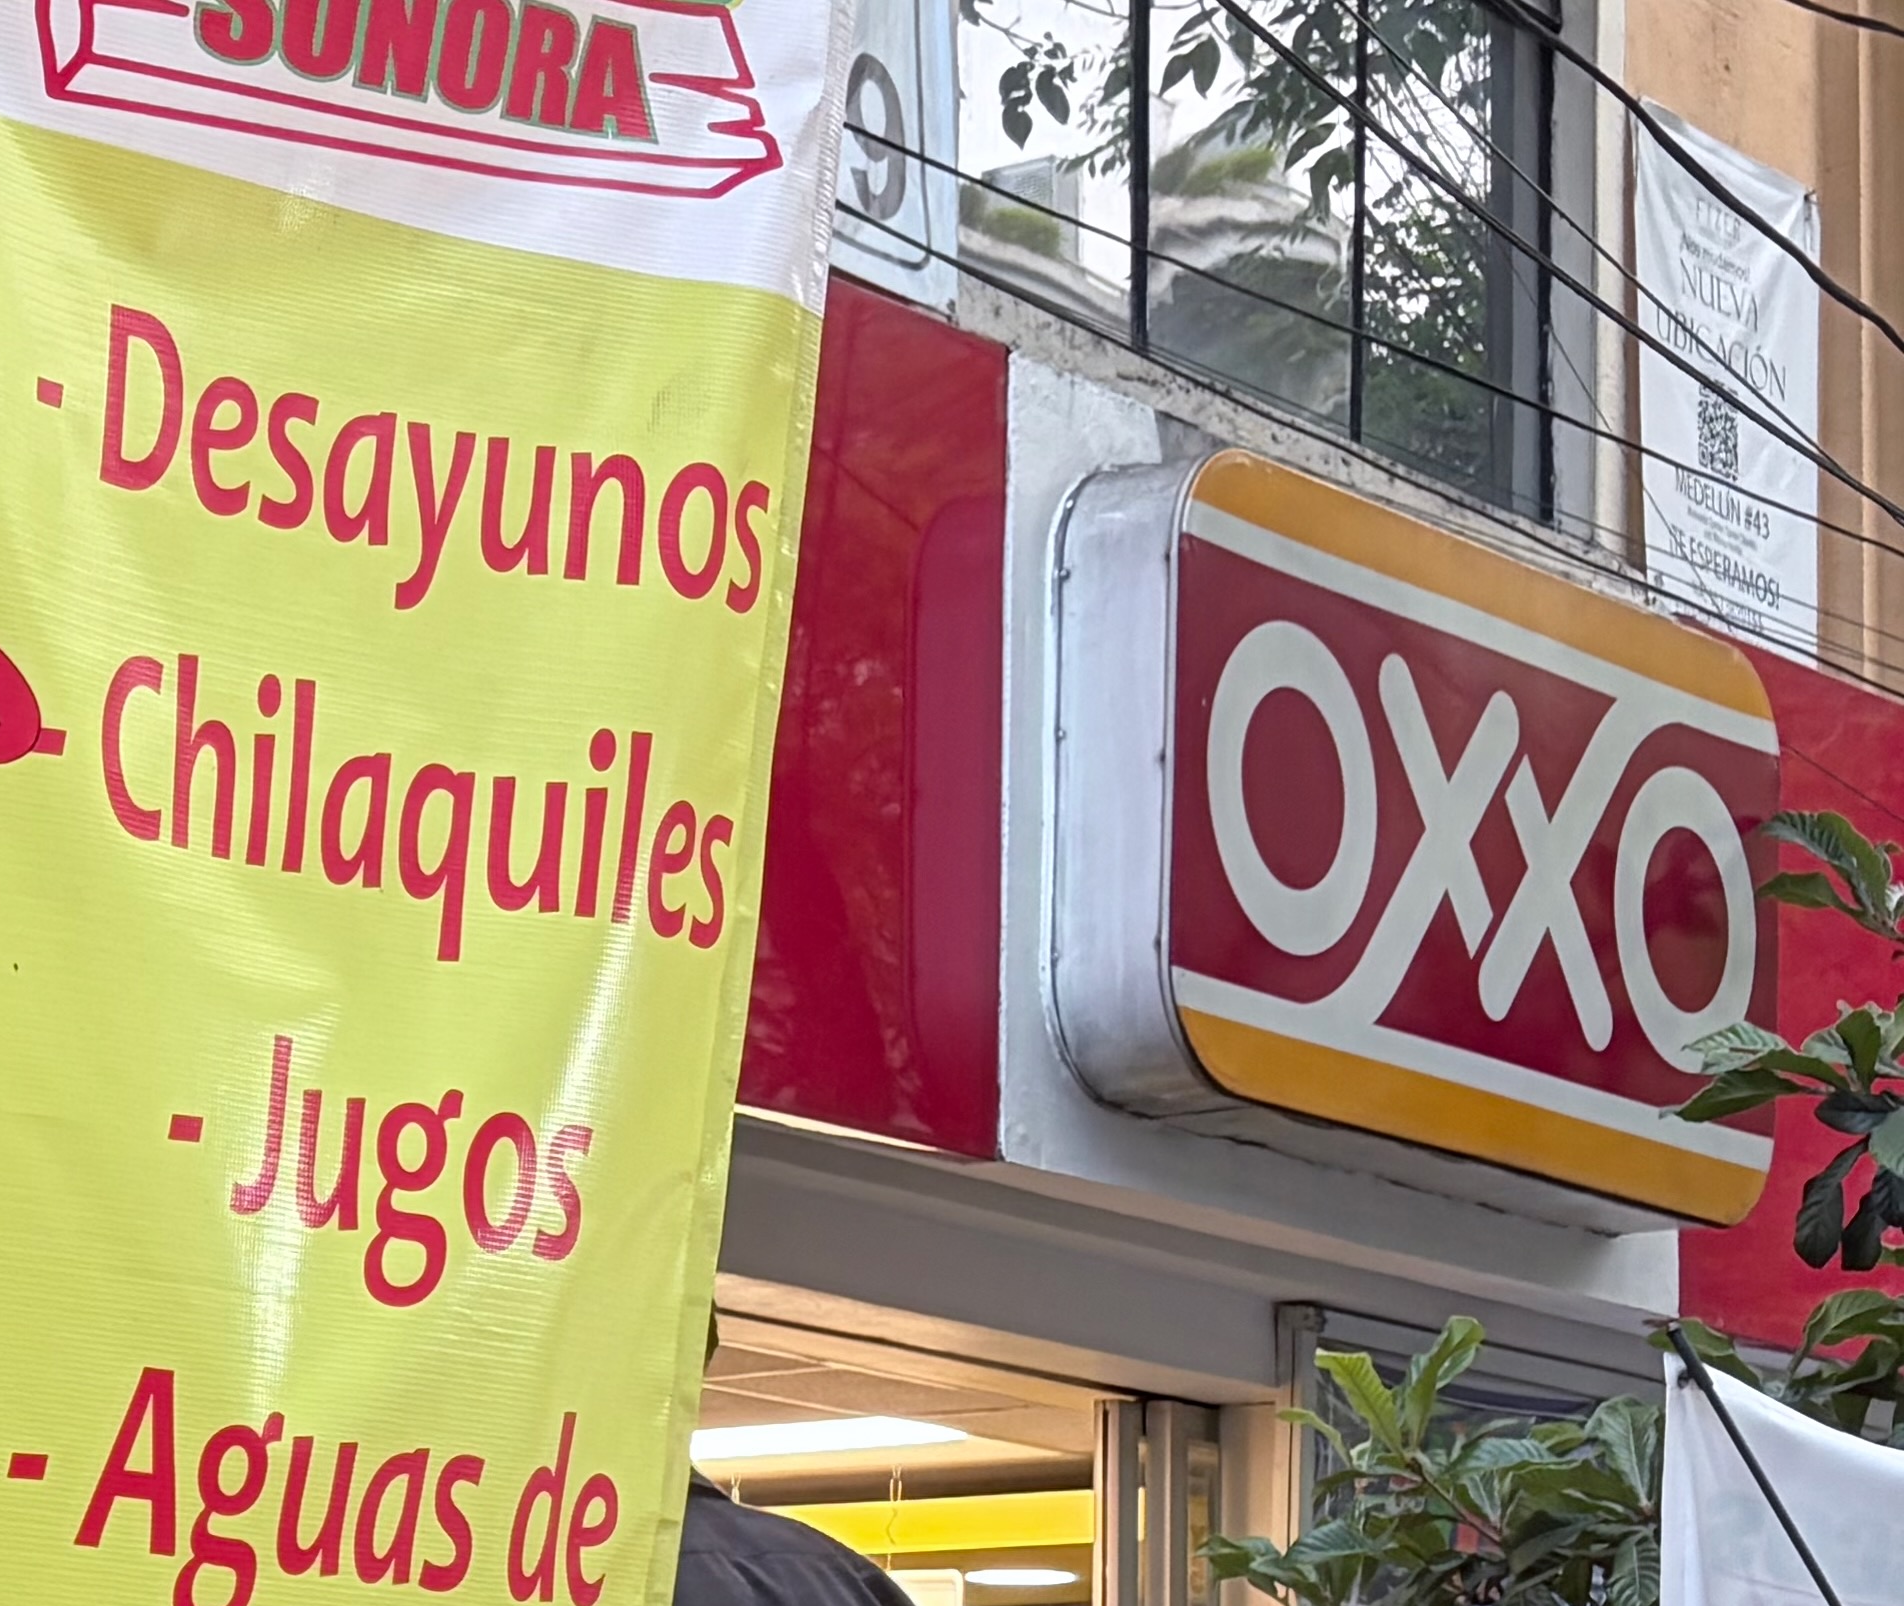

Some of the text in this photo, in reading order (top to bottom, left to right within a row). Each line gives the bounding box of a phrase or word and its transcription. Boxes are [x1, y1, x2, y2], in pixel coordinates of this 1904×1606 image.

[192, 0, 659, 144] SONORA
[1655, 306, 1788, 402] UBICACIÓN
[1679, 257, 1759, 333] NUEVA
[99, 303, 770, 613] Desayunos
[1744, 503, 1770, 540] #43
[101, 652, 733, 961] Chilaquiles
[1206, 618, 1757, 1075] OXXO
[230, 1034, 592, 1309] Jugos
